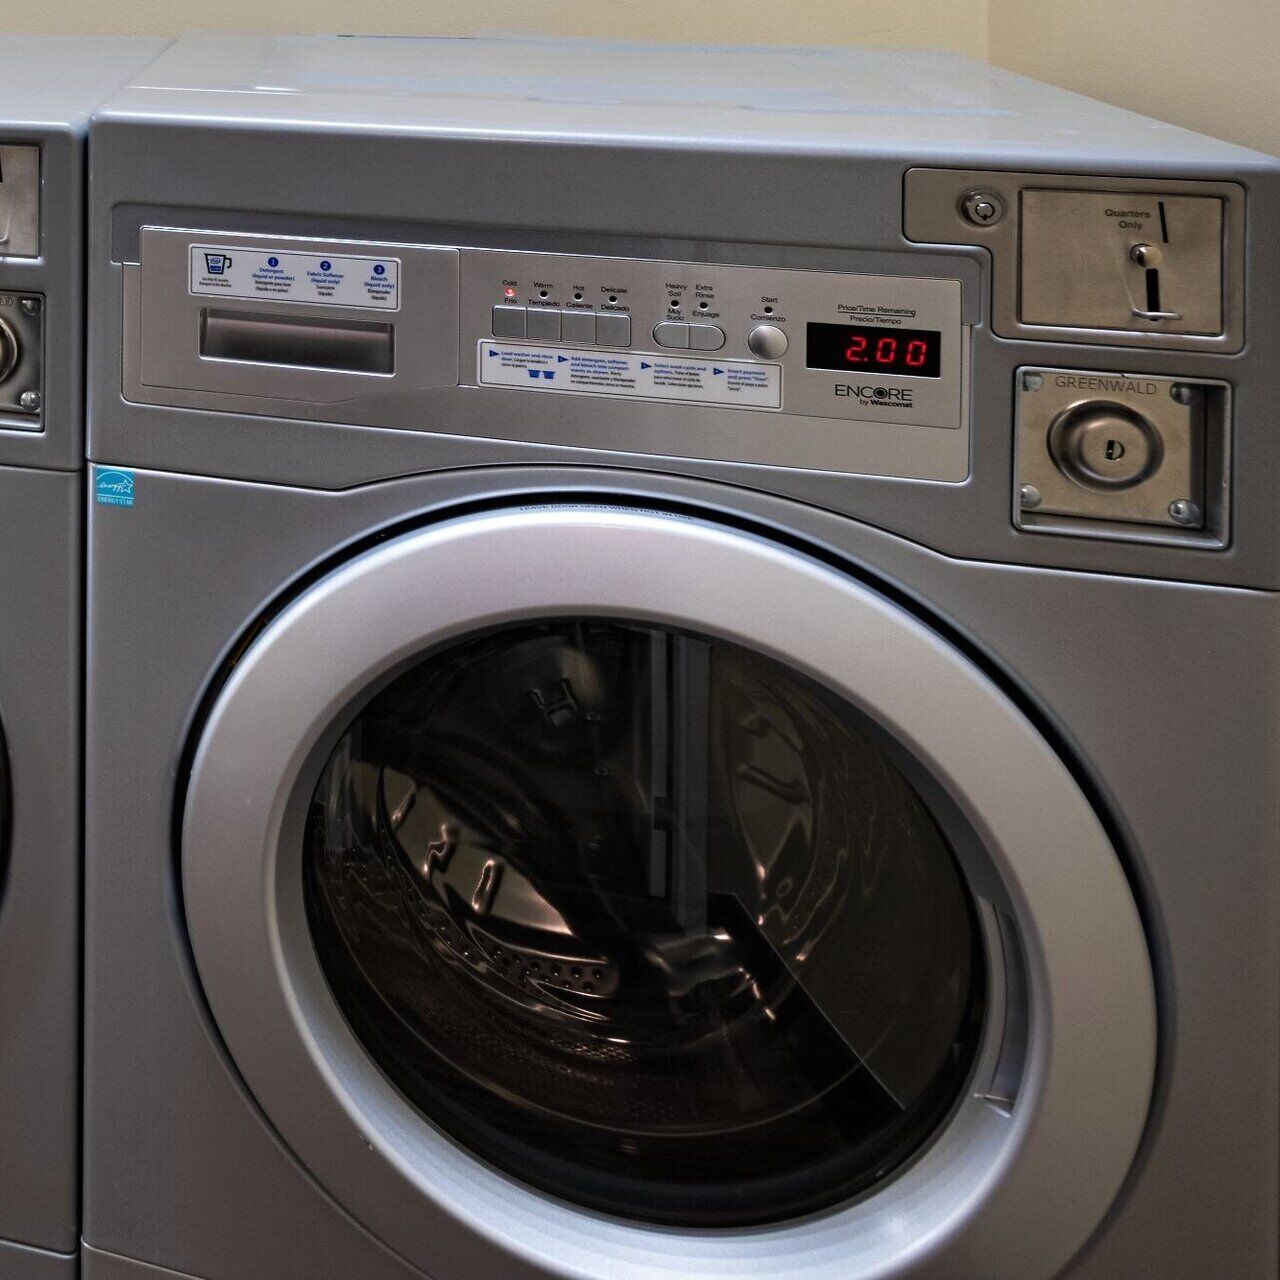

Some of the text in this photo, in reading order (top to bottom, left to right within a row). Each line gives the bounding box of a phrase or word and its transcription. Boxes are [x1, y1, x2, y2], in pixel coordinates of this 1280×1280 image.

[1104, 208, 1151, 219] Quarters
[1118, 220, 1144, 231] Only
[600, 286, 627, 294] Delicate
[666, 283, 688, 291] Heavy
[695, 291, 715, 299] Rinse
[528, 299, 560, 308] Templado
[761, 296, 778, 304] Start
[566, 301, 593, 310] Caliente
[601, 304, 630, 312] Delicado
[837, 304, 916, 316] Price/Time Remaining
[750, 314, 786, 322] Comienzo
[850, 315, 902, 325] Precio/Tiempo
[845, 336, 928, 366] 2.00
[1055, 375, 1158, 395] GREENWALD
[835, 384, 913, 402] ENCORE
[859, 399, 913, 408] by Wascomat
